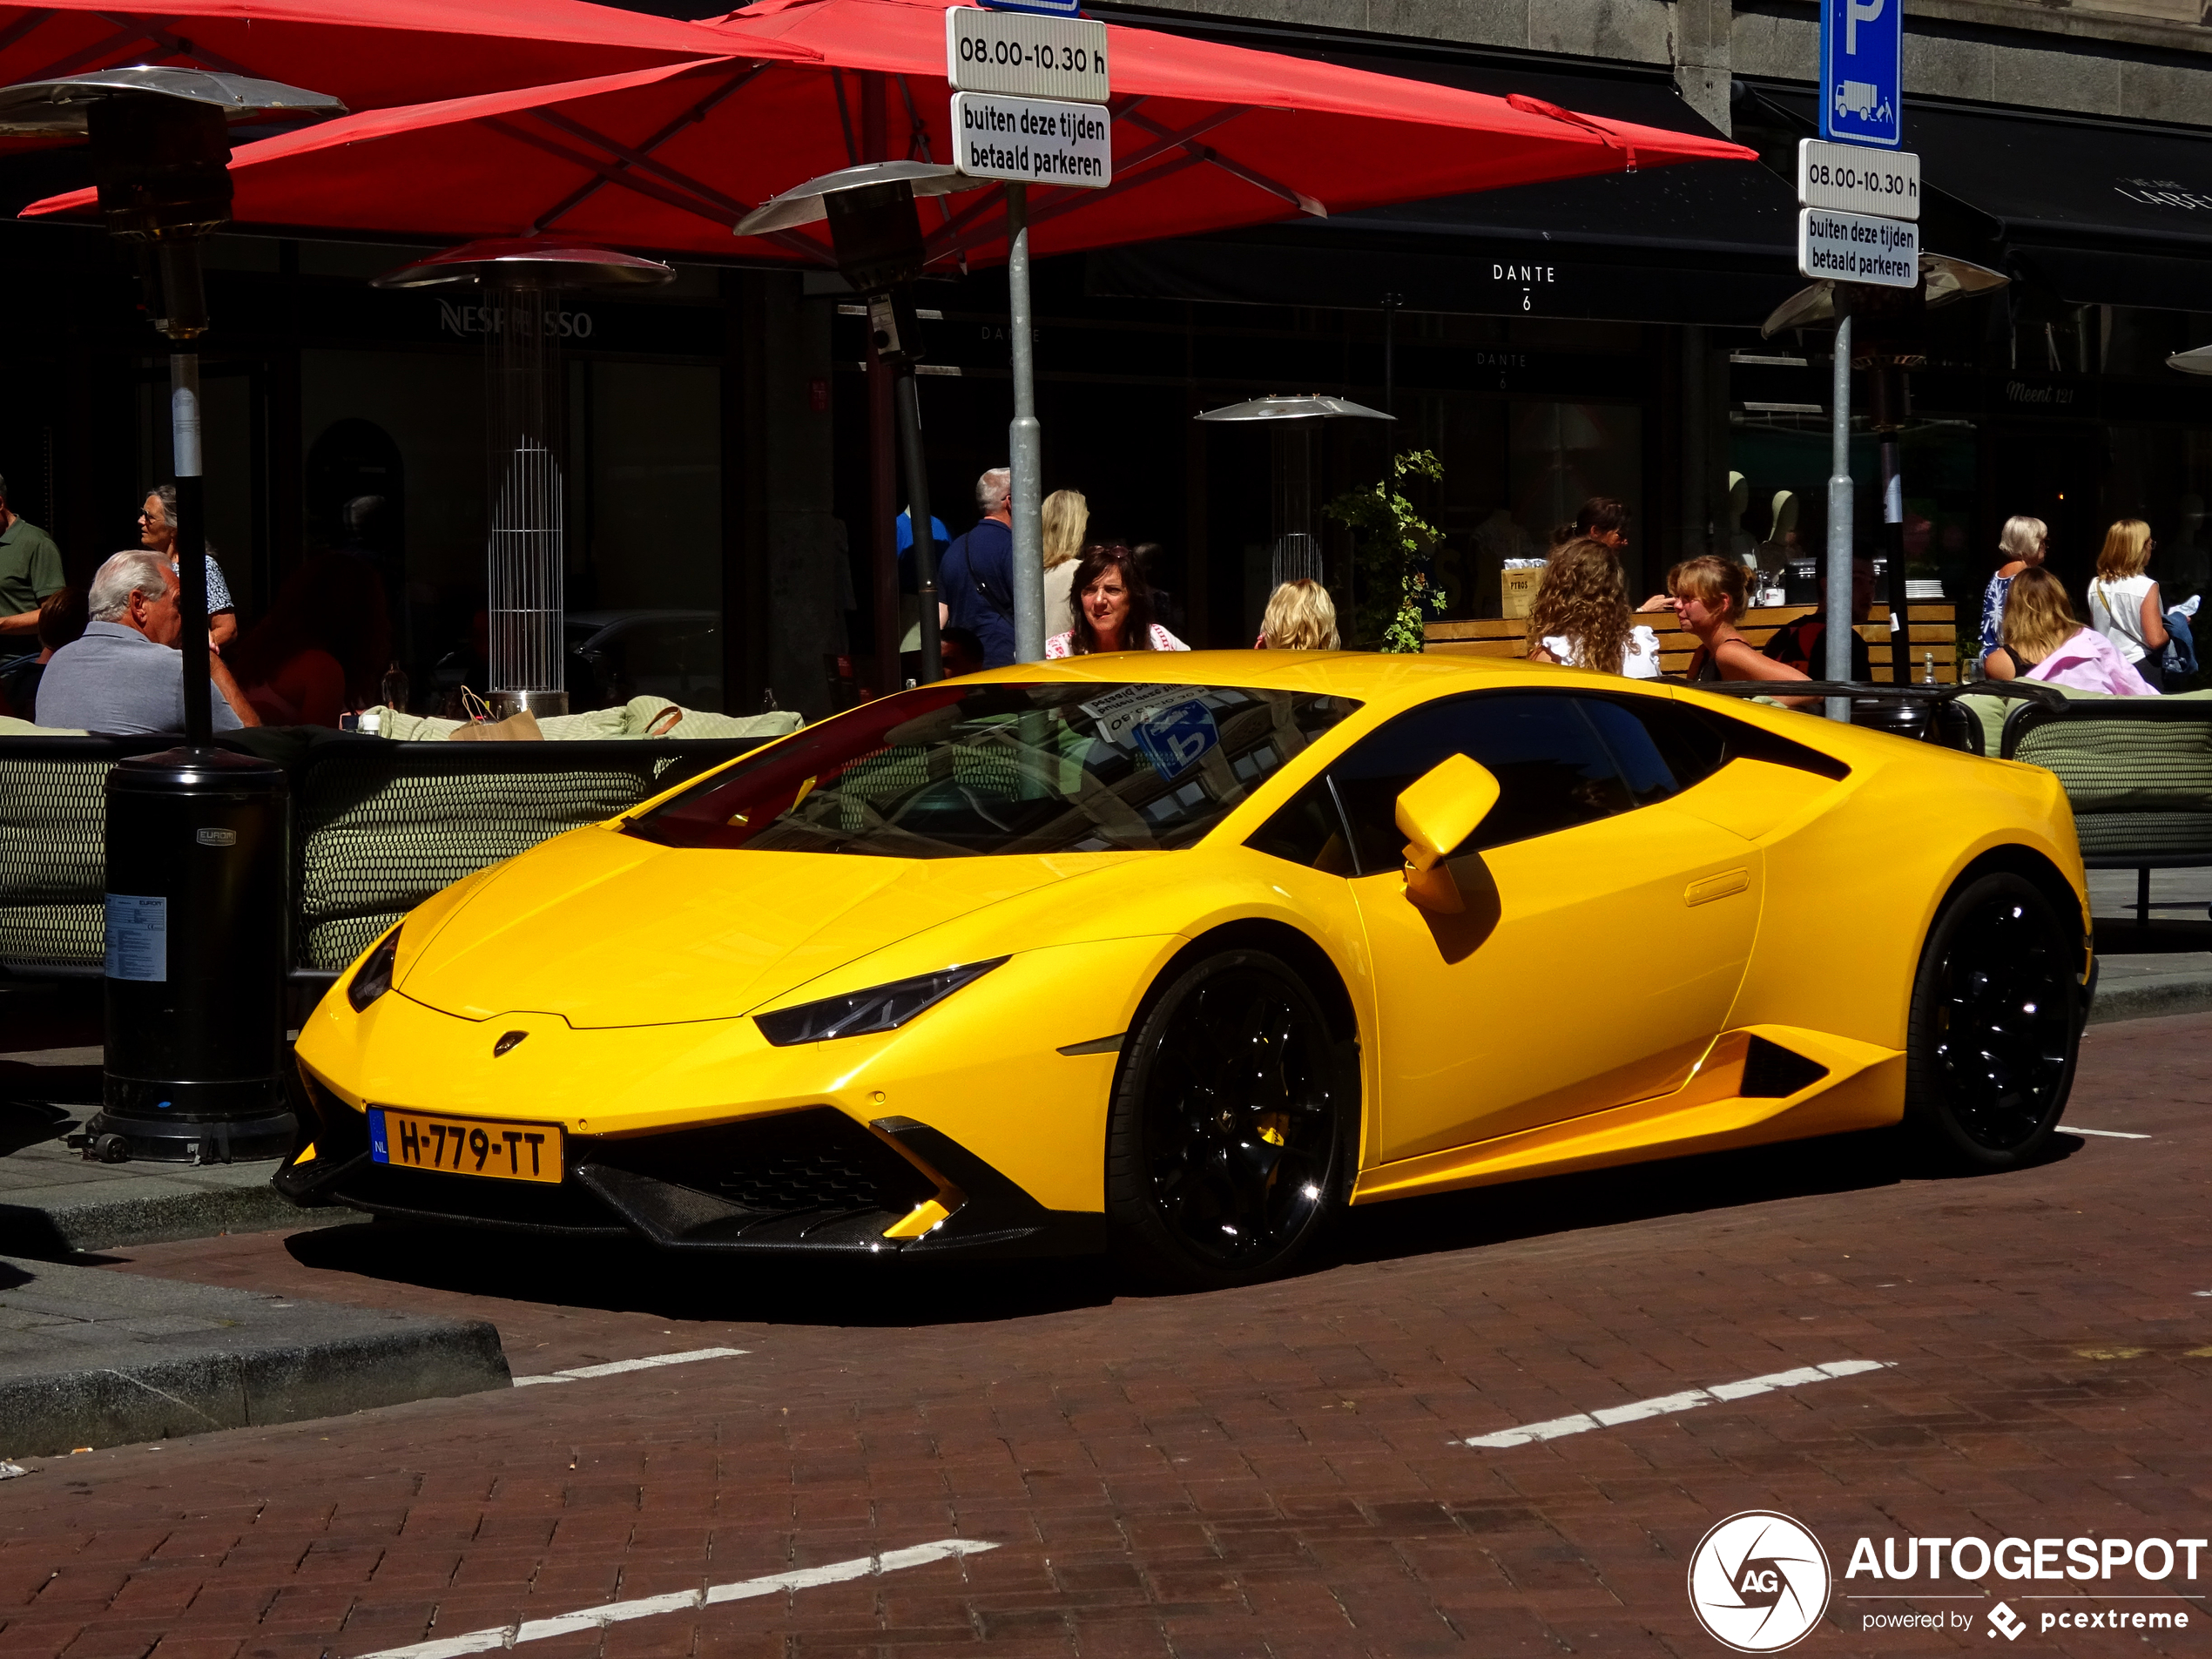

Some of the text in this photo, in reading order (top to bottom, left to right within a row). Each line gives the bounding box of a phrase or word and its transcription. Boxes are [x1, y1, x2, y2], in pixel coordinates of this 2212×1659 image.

[1846, 0, 1885, 55] P
[961, 37, 1104, 74] 08.00-10.30 h
[964, 103, 1104, 146] buiten deze tijden
[971, 141, 1102, 177] betaald parkeren
[1810, 164, 1917, 197] 08.00-10.30 h
[1810, 215, 1913, 253] buiten deze tijden
[1494, 264, 1554, 283] DANTE
[1812, 246, 1910, 278] betaald parkeren
[1523, 295, 1531, 311] 6
[1477, 353, 1526, 367] DANTE
[2006, 381, 2074, 403] Meent 121
[374, 1140, 387, 1154] NL
[399, 1120, 544, 1176] H-779-TT
